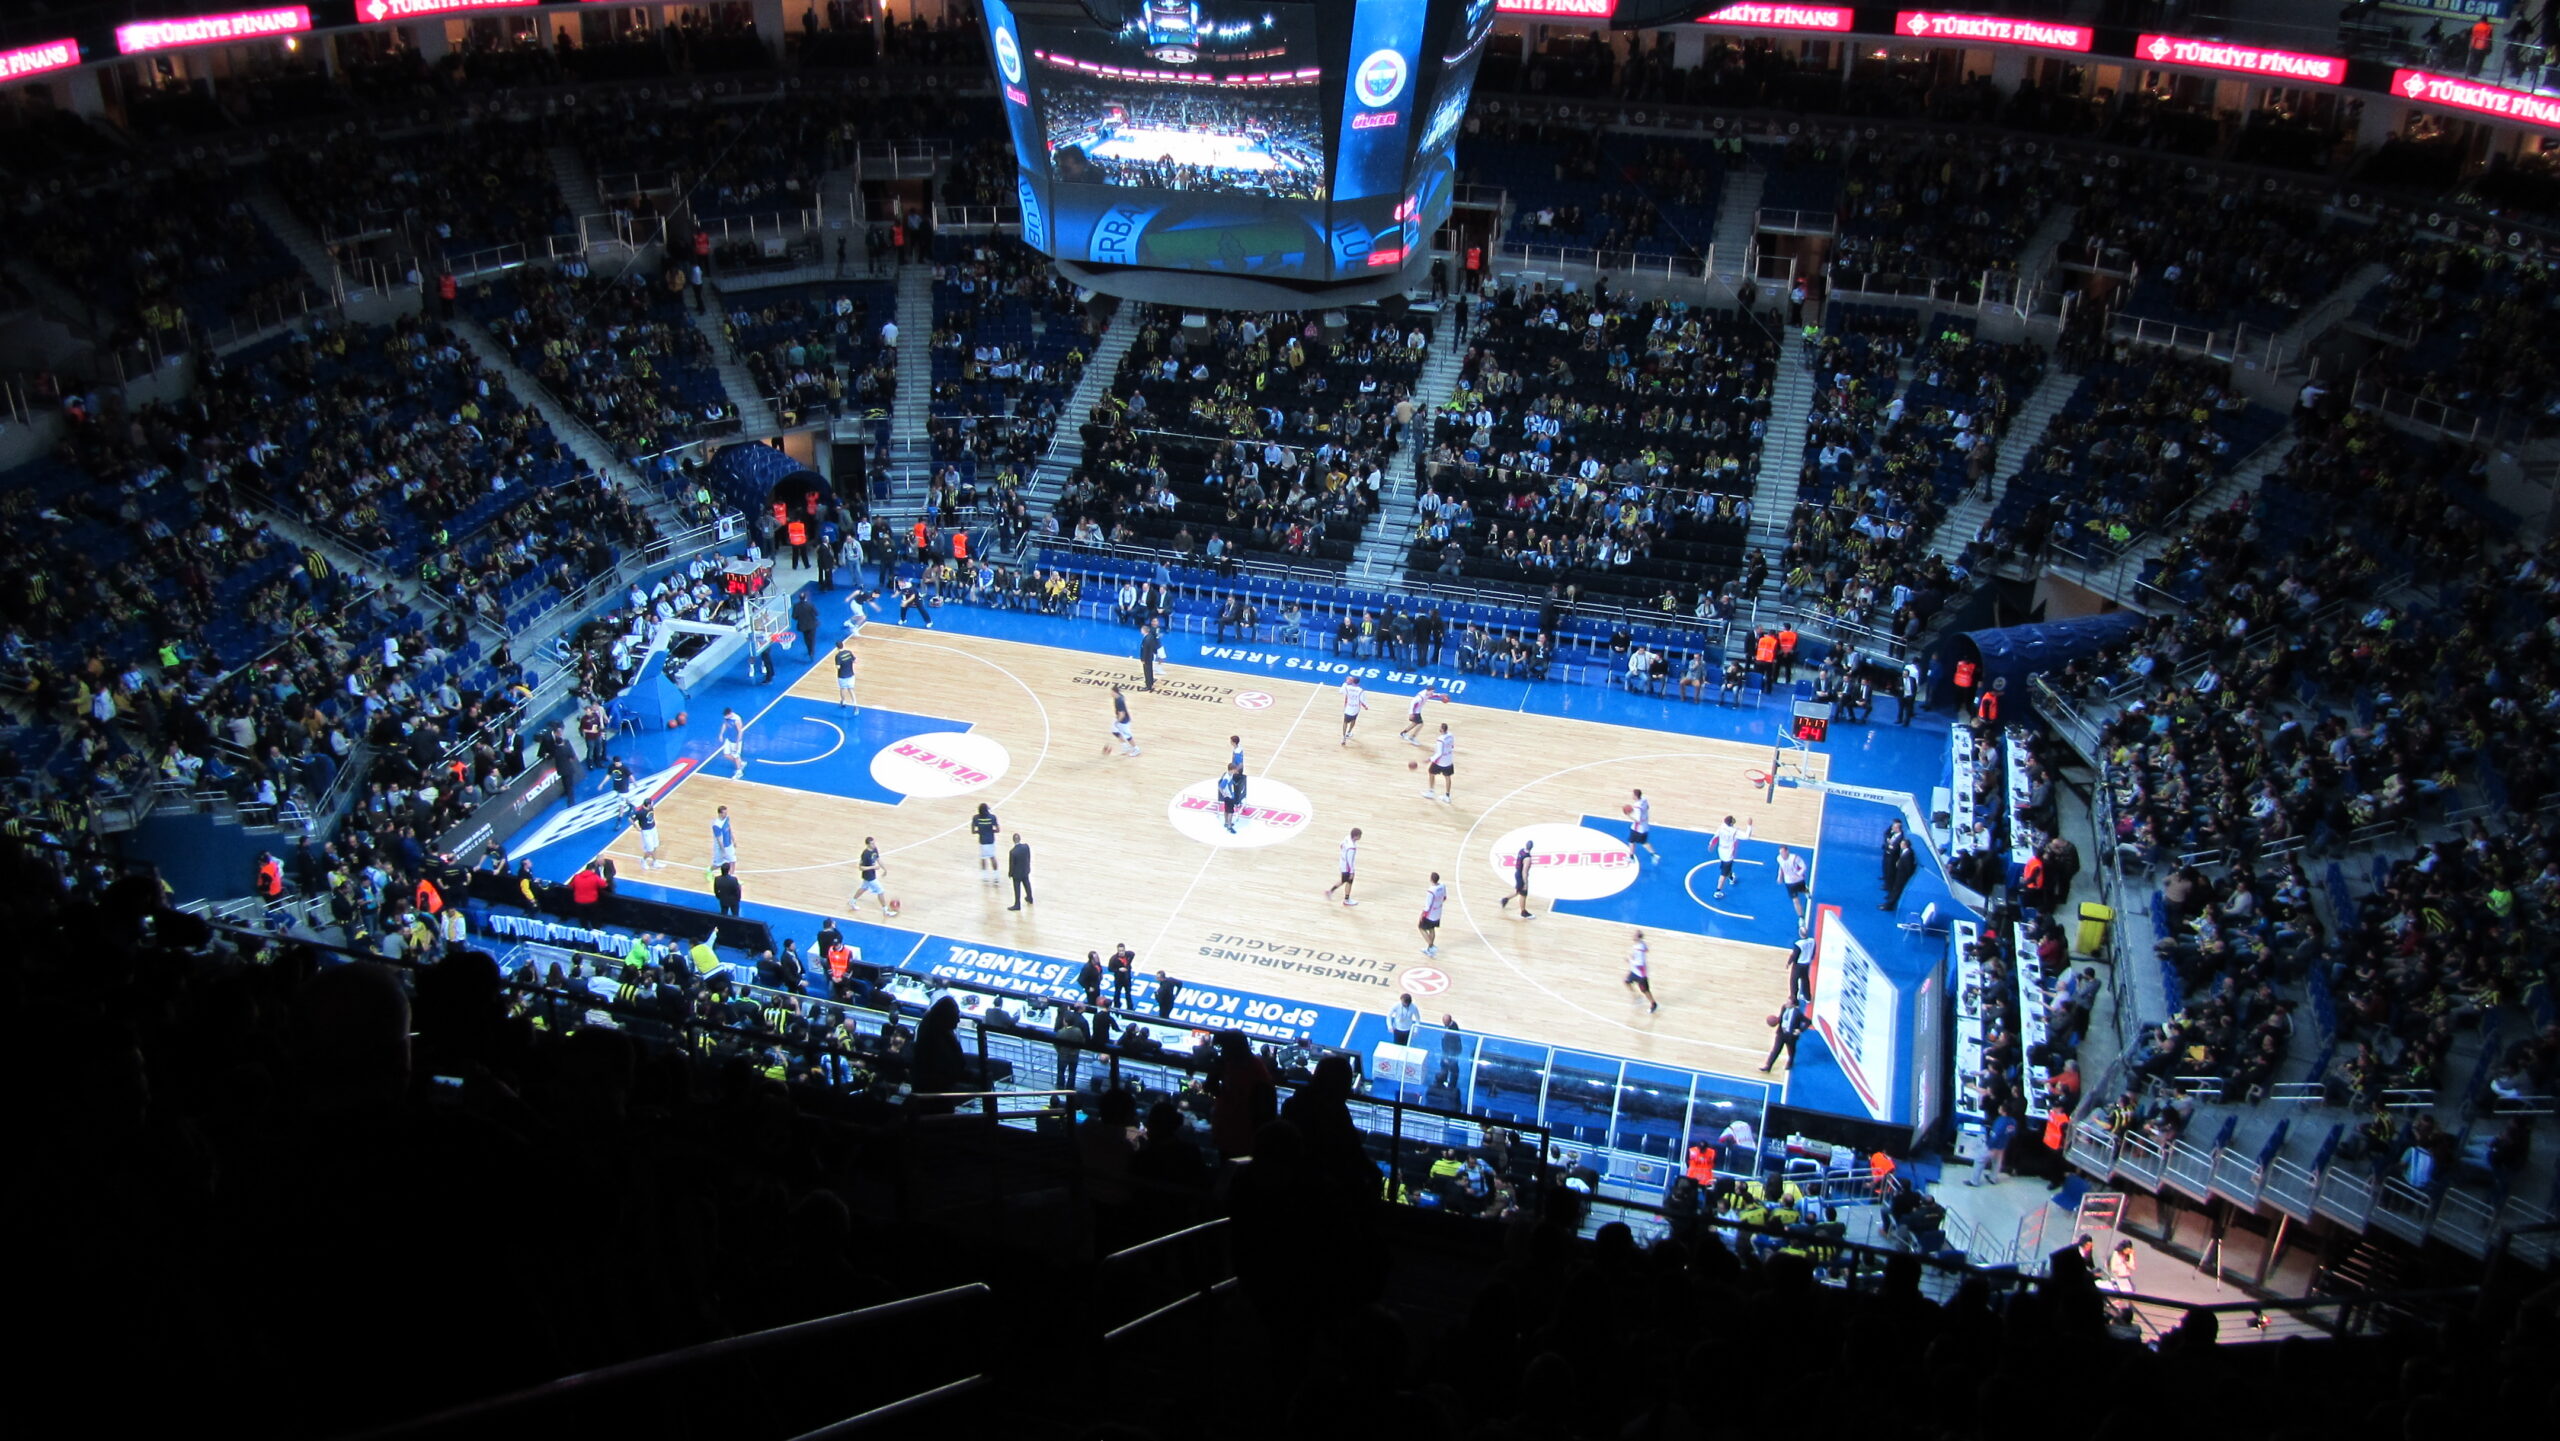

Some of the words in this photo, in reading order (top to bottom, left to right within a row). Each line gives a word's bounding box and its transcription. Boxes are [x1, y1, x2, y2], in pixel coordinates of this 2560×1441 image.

[150, 19, 231, 44] TÜRKİYE
[232, 11, 299, 36] FİNANS
[1773, 6, 1839, 27] FİNANS
[1932, 16, 2011, 39] TÜRKİYE
[2011, 22, 2079, 47] FİNANS
[9, 44, 69, 74] FİNANS
[2173, 42, 2257, 69] TÜRKİYE
[2259, 52, 2331, 79] FİNANS
[2428, 78, 2510, 112] TÜRKİYE
[1352, 111, 1398, 130] ÜLKER
[728, 580, 747, 594] 24
[1200, 645, 1281, 666] ARENA
[1284, 656, 1381, 680] SPORTS
[1387, 671, 1467, 694] ÜLKER
[1798, 726, 1822, 741] 24
[892, 743, 989, 785] ÜLKER
[1206, 932, 1397, 972] EUROLEAGUE
[1244, 999, 1319, 1027] SPOR
